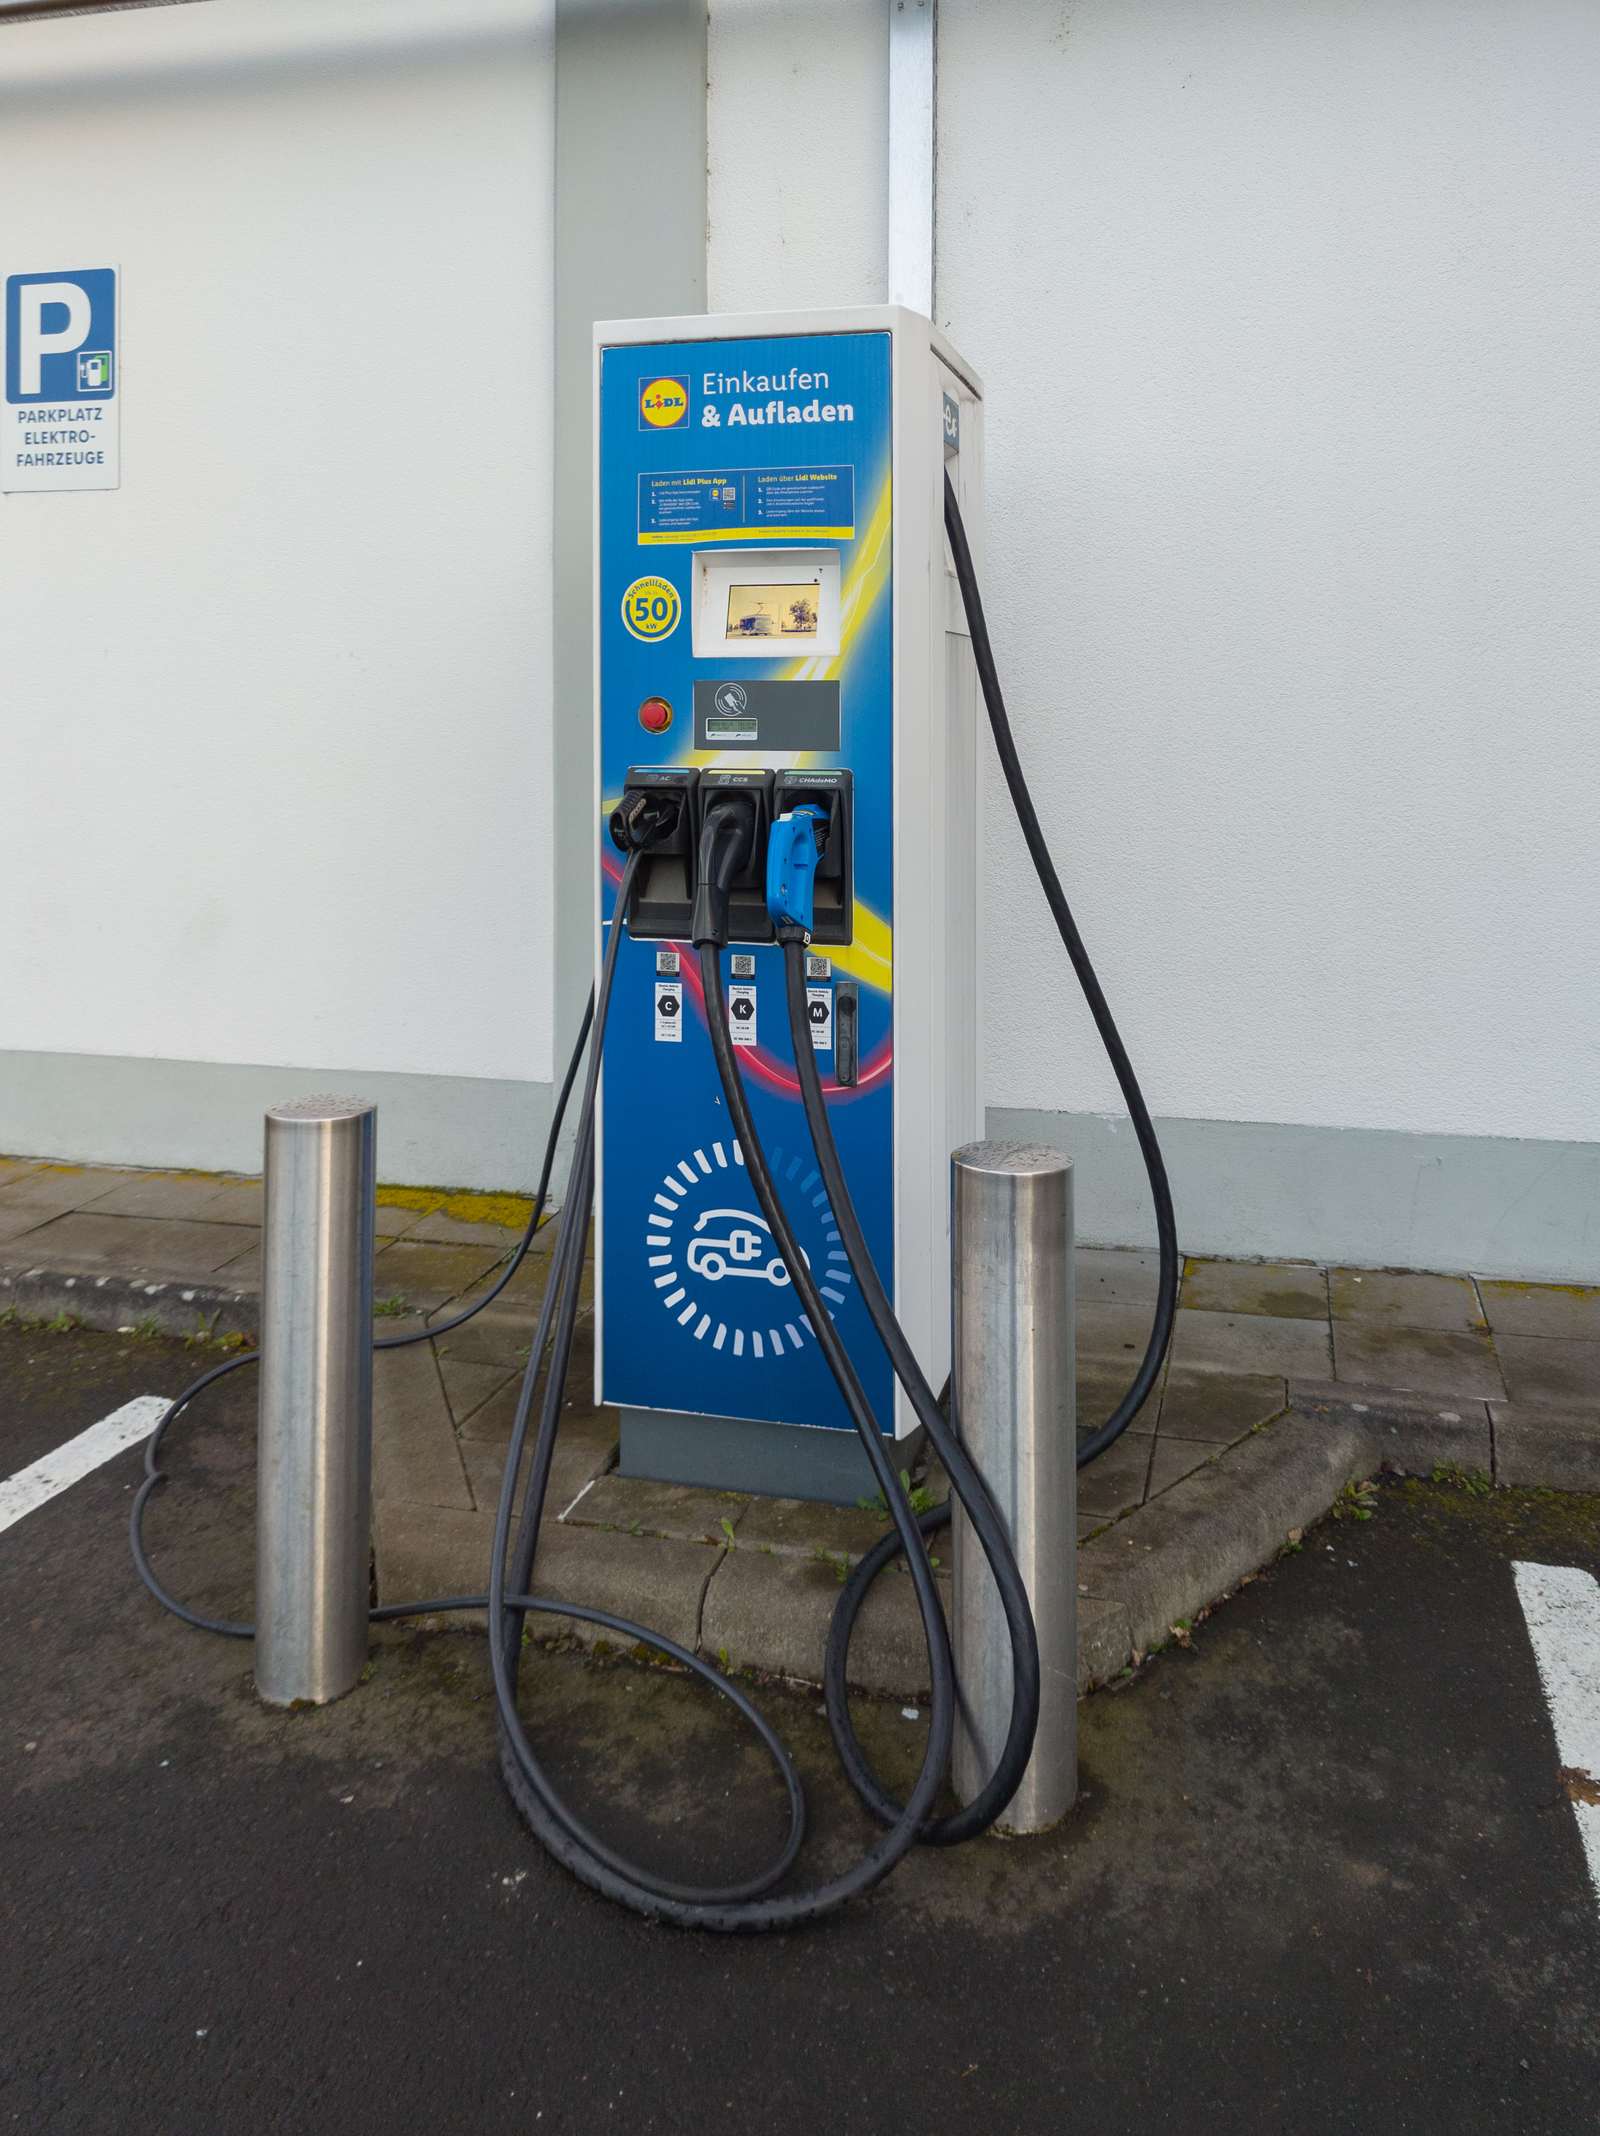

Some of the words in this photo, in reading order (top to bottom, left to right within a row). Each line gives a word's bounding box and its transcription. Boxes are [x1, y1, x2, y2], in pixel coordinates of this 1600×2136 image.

[20, 282, 92, 395] P
[703, 368, 829, 395] Einkaufen
[18, 407, 103, 424] PARKPLATZ
[701, 404, 721, 428] &
[728, 400, 855, 426] Aufladen
[25, 429, 96, 445] ELEKTRO-
[16, 451, 105, 467] FAHRZEUGE
[683, 478, 696, 486] Lidl
[712, 477, 727, 486] App
[757, 475, 778, 483] Laden
[809, 472, 838, 481] Website
[635, 597, 668, 622] 50
[665, 1001, 673, 1011] C
[739, 1004, 747, 1014] K
[813, 1007, 823, 1018] M
